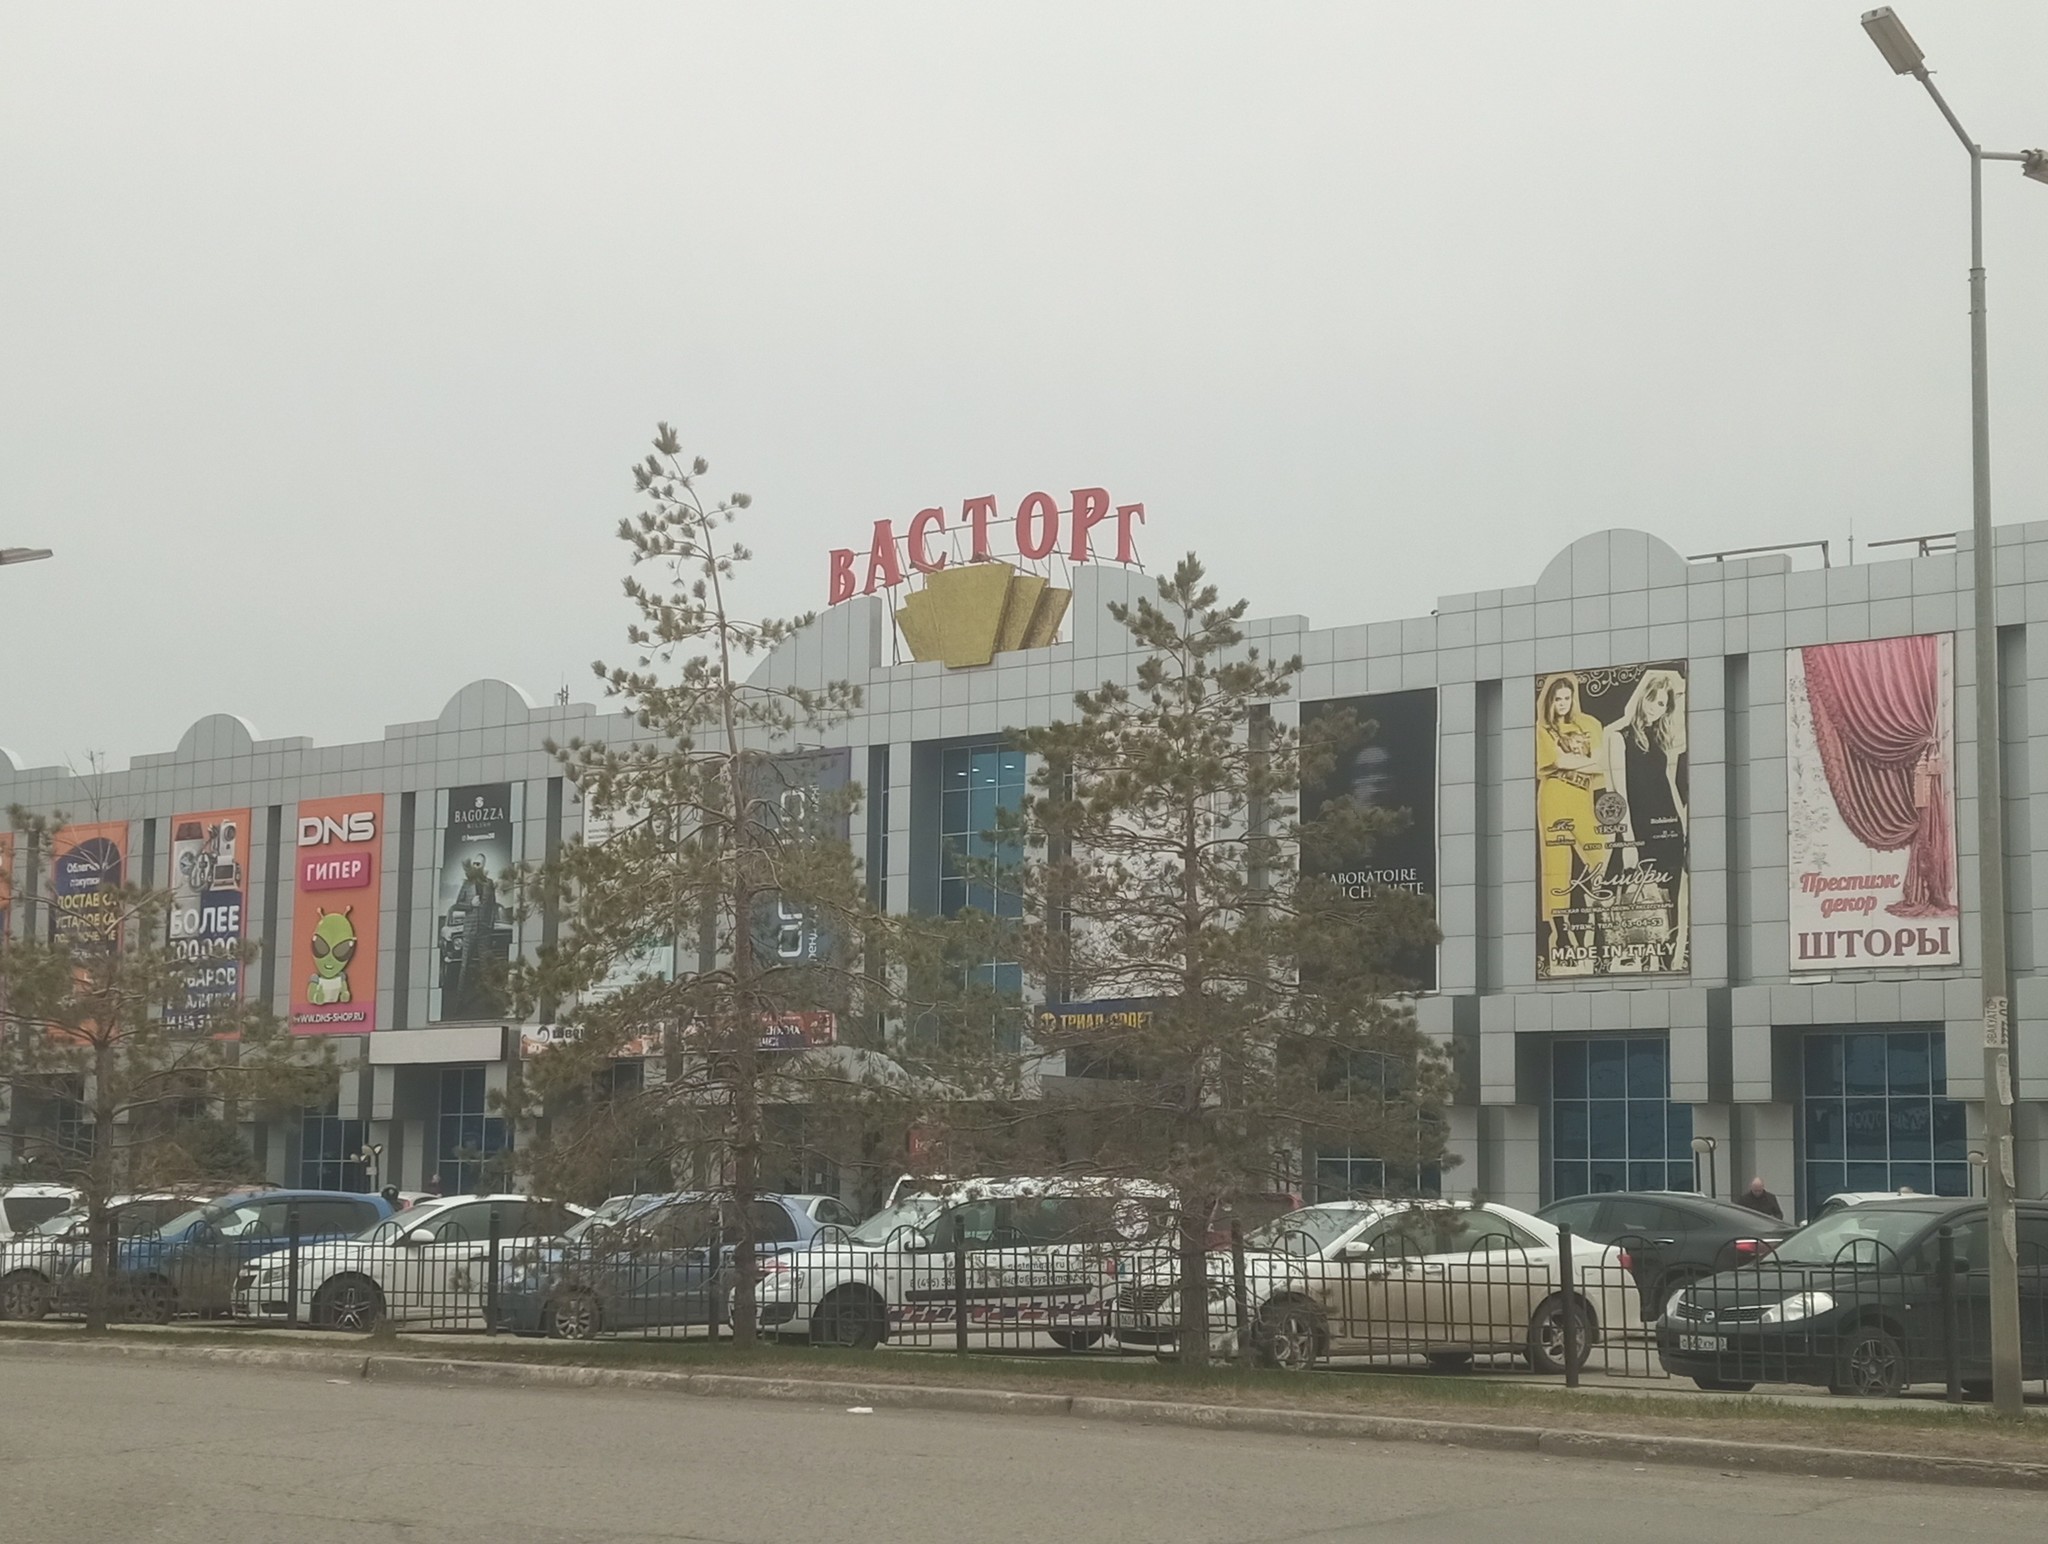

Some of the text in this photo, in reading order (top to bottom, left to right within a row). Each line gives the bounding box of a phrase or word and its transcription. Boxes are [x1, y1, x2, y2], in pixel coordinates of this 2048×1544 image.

[829, 487, 1146, 605] ВАСТОРГ
[454, 807, 504, 823] BAGOZZA
[297, 811, 375, 846] DNS
[306, 860, 362, 882] ГИПЕР
[1322, 868, 1417, 885] ABORATOIRE
[1551, 859, 1674, 904] Колибри
[1800, 872, 1902, 898] Престиж
[1820, 896, 1878, 918] декор
[170, 905, 240, 937] БОЛЕЕ
[1551, 942, 1677, 961] MADE IN ITALY
[1798, 927, 1951, 960] ШТОРЫ
